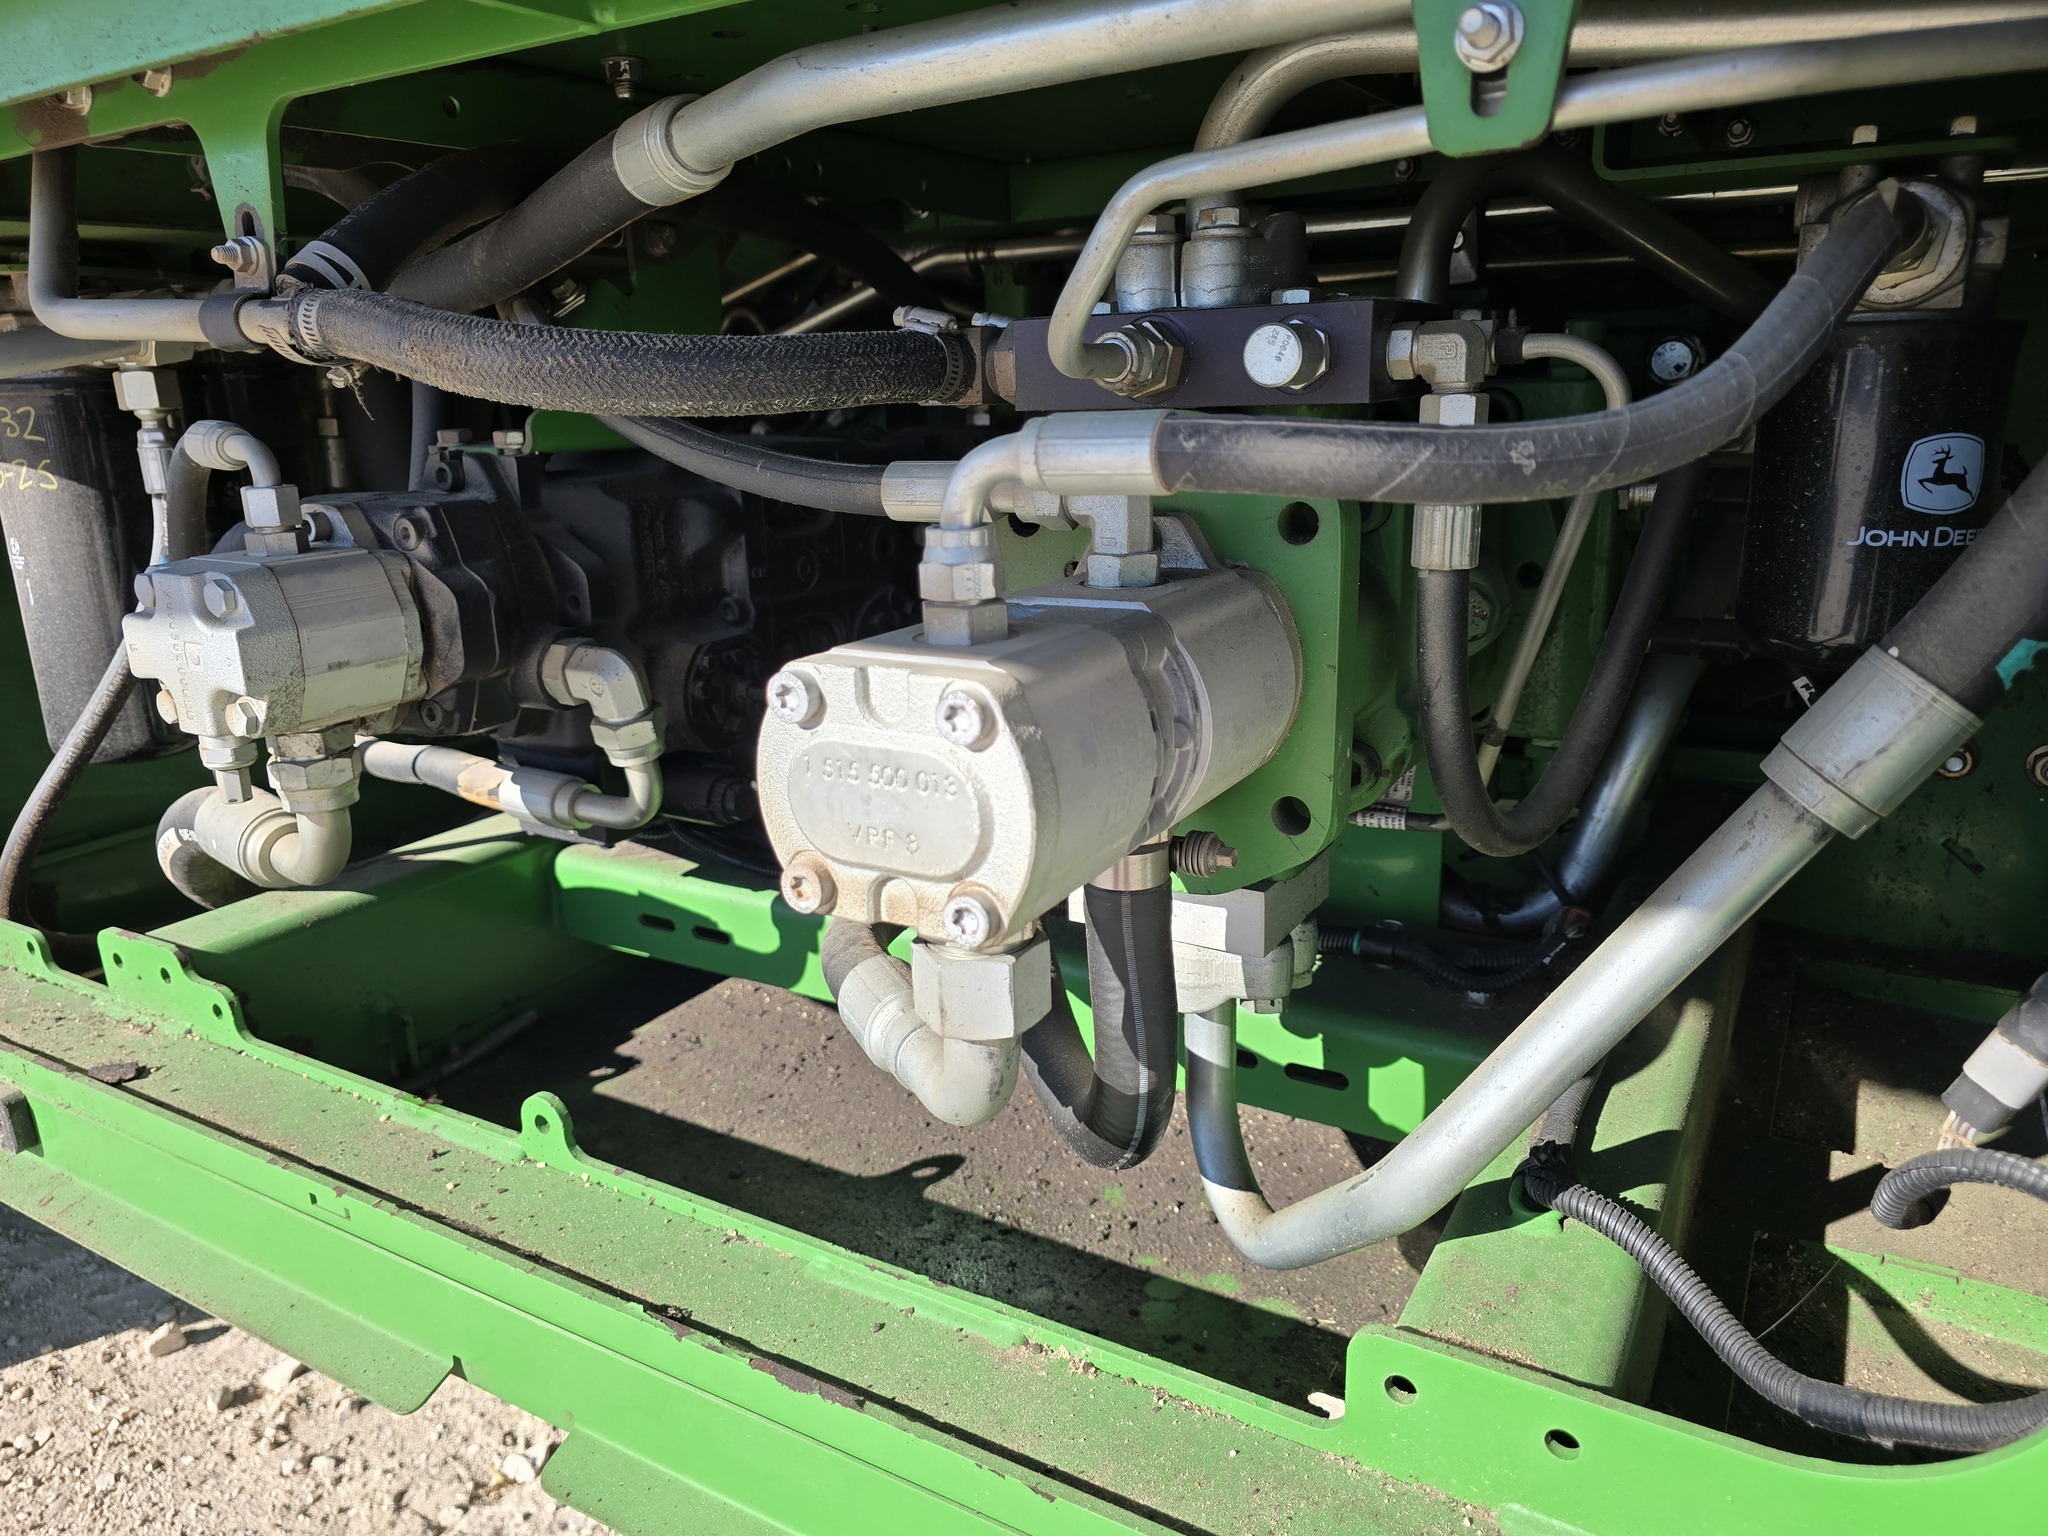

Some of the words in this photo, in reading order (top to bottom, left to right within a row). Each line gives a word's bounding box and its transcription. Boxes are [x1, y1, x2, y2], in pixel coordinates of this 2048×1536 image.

[1846, 525, 1930, 548] JOHN
[1933, 526, 1984, 547] DEE
[867, 764, 909, 791] 500
